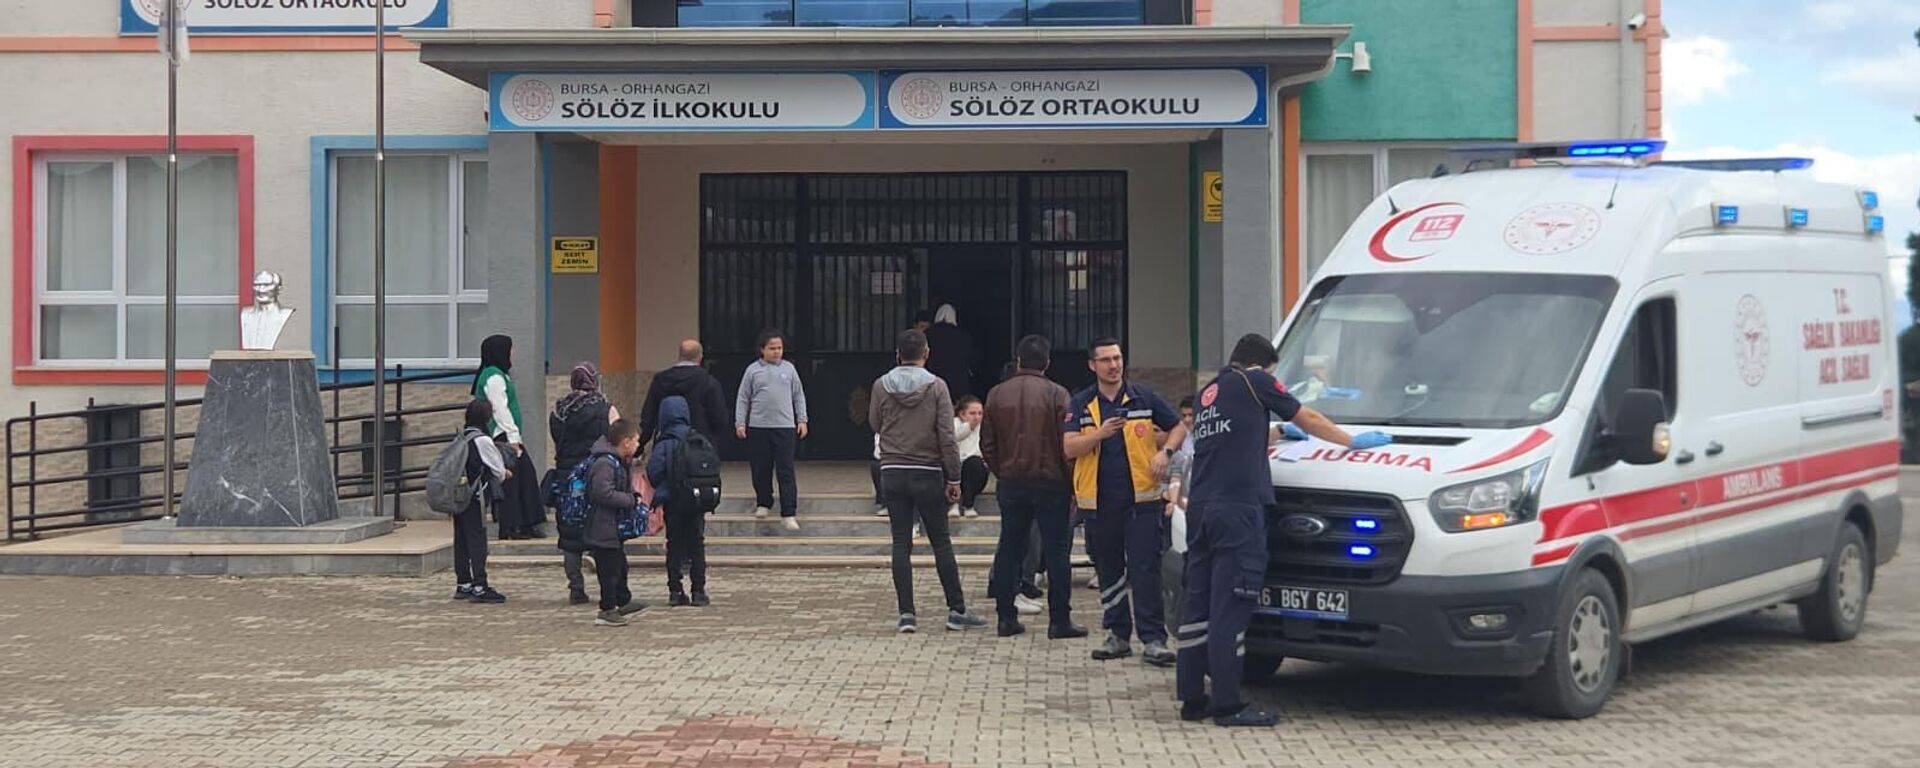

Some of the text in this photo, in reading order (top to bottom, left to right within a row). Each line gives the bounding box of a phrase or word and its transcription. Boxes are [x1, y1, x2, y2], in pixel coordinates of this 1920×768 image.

[560, 84, 609, 95] BURSA
[622, 82, 711, 95] ORHANGAZİ
[949, 81, 997, 93] BURSA
[1010, 80, 1100, 92] ORHANGAZİ
[561, 98, 780, 119] SÖLÖZ İLKOKULU
[950, 96, 1200, 116] SÖLÖZ ORTAOKULU
[1423, 218, 1454, 230] 112
[1194, 419, 1231, 440] AĞLIK
[1723, 466, 1782, 500] AMBULANS
[1258, 587, 1345, 612] 6 BGY 642
